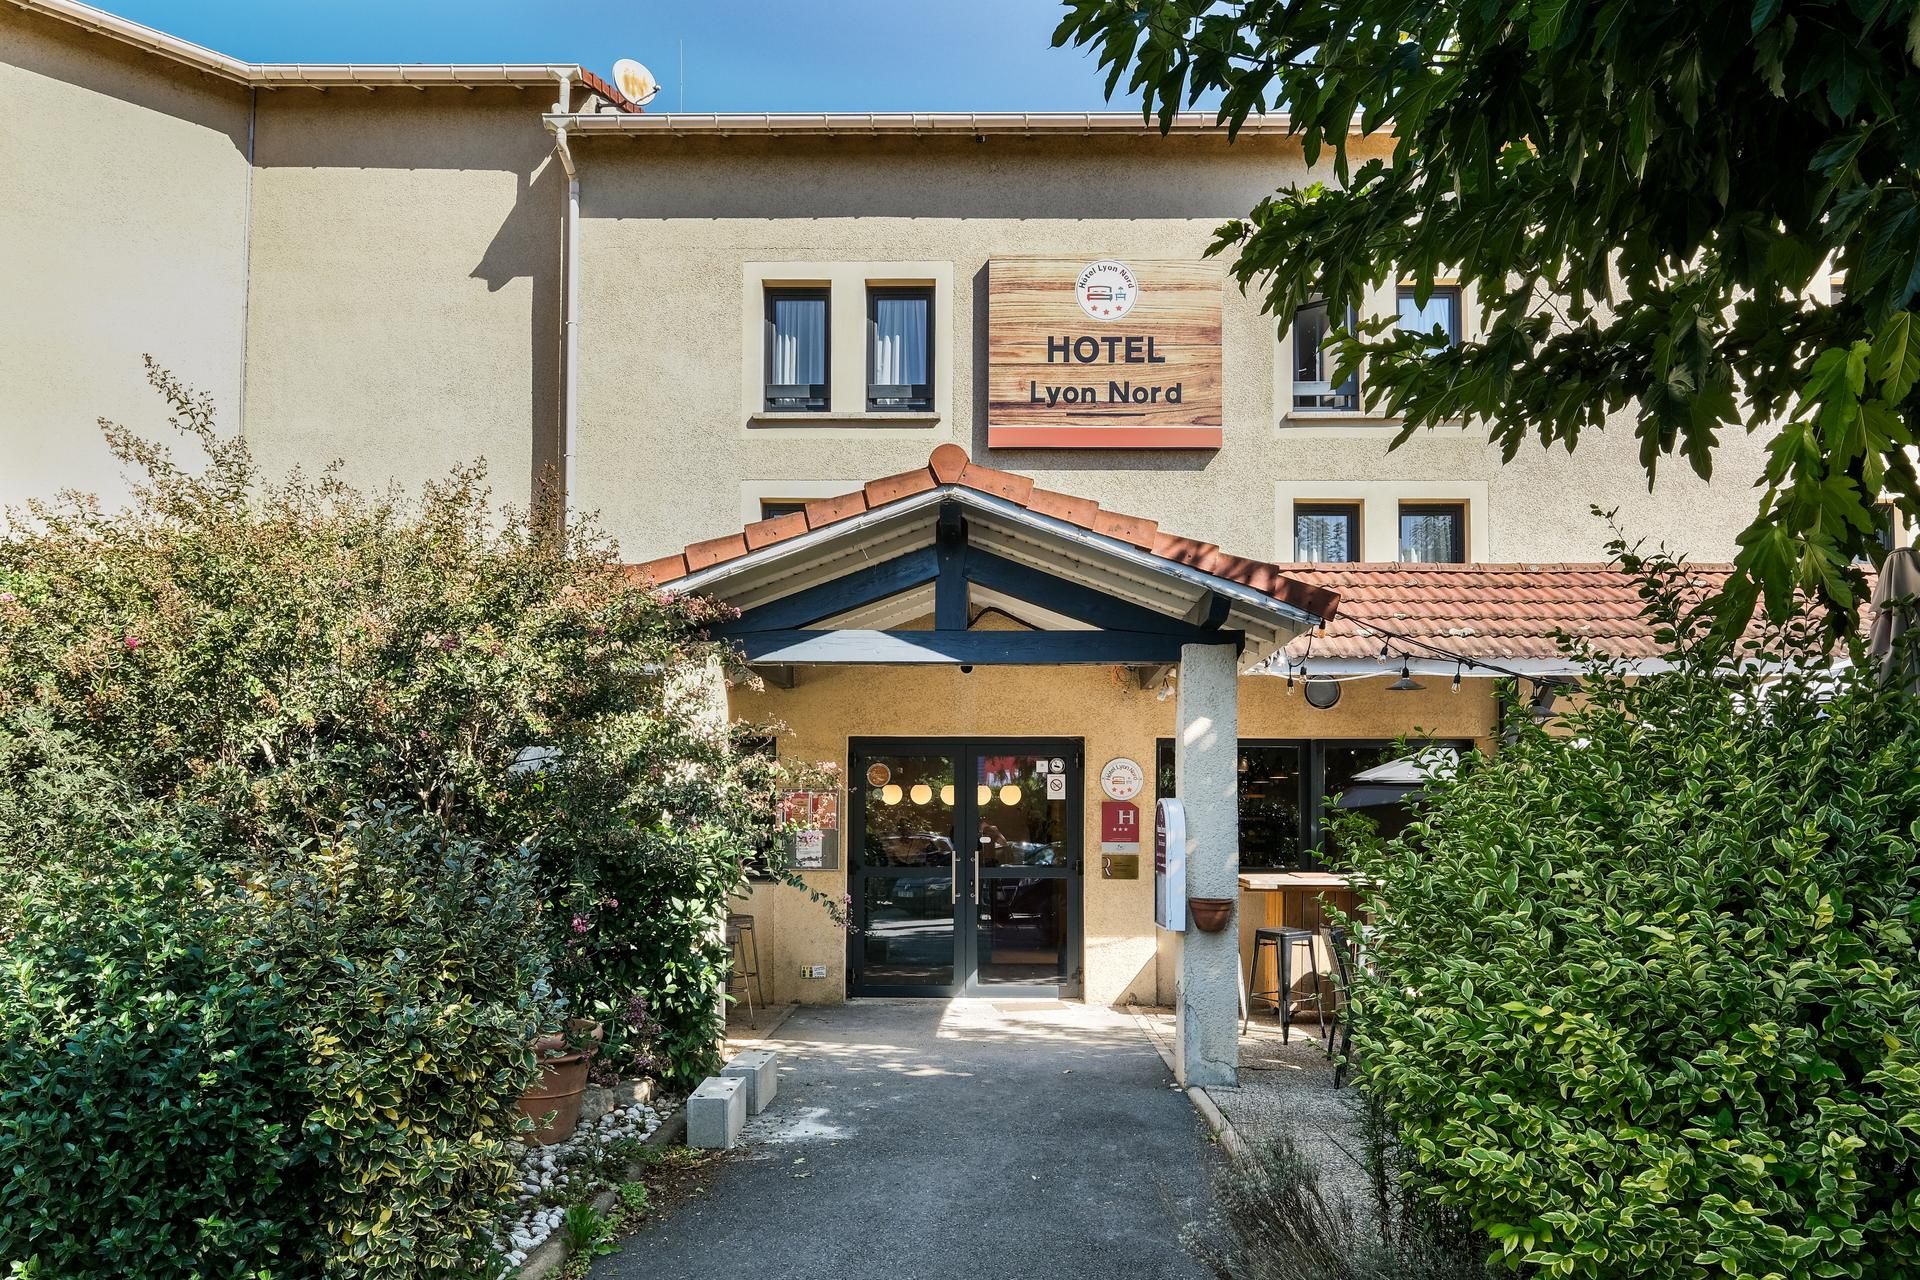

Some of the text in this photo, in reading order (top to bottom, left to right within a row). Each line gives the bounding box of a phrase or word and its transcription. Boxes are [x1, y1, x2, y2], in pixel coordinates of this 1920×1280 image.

[1097, 264, 1118, 273] Lyon
[1119, 269, 1135, 289] Nord
[1047, 335, 1166, 364] HOTEL
[1030, 380, 1182, 408] Lyon Nord
[1119, 810, 1134, 824] H
